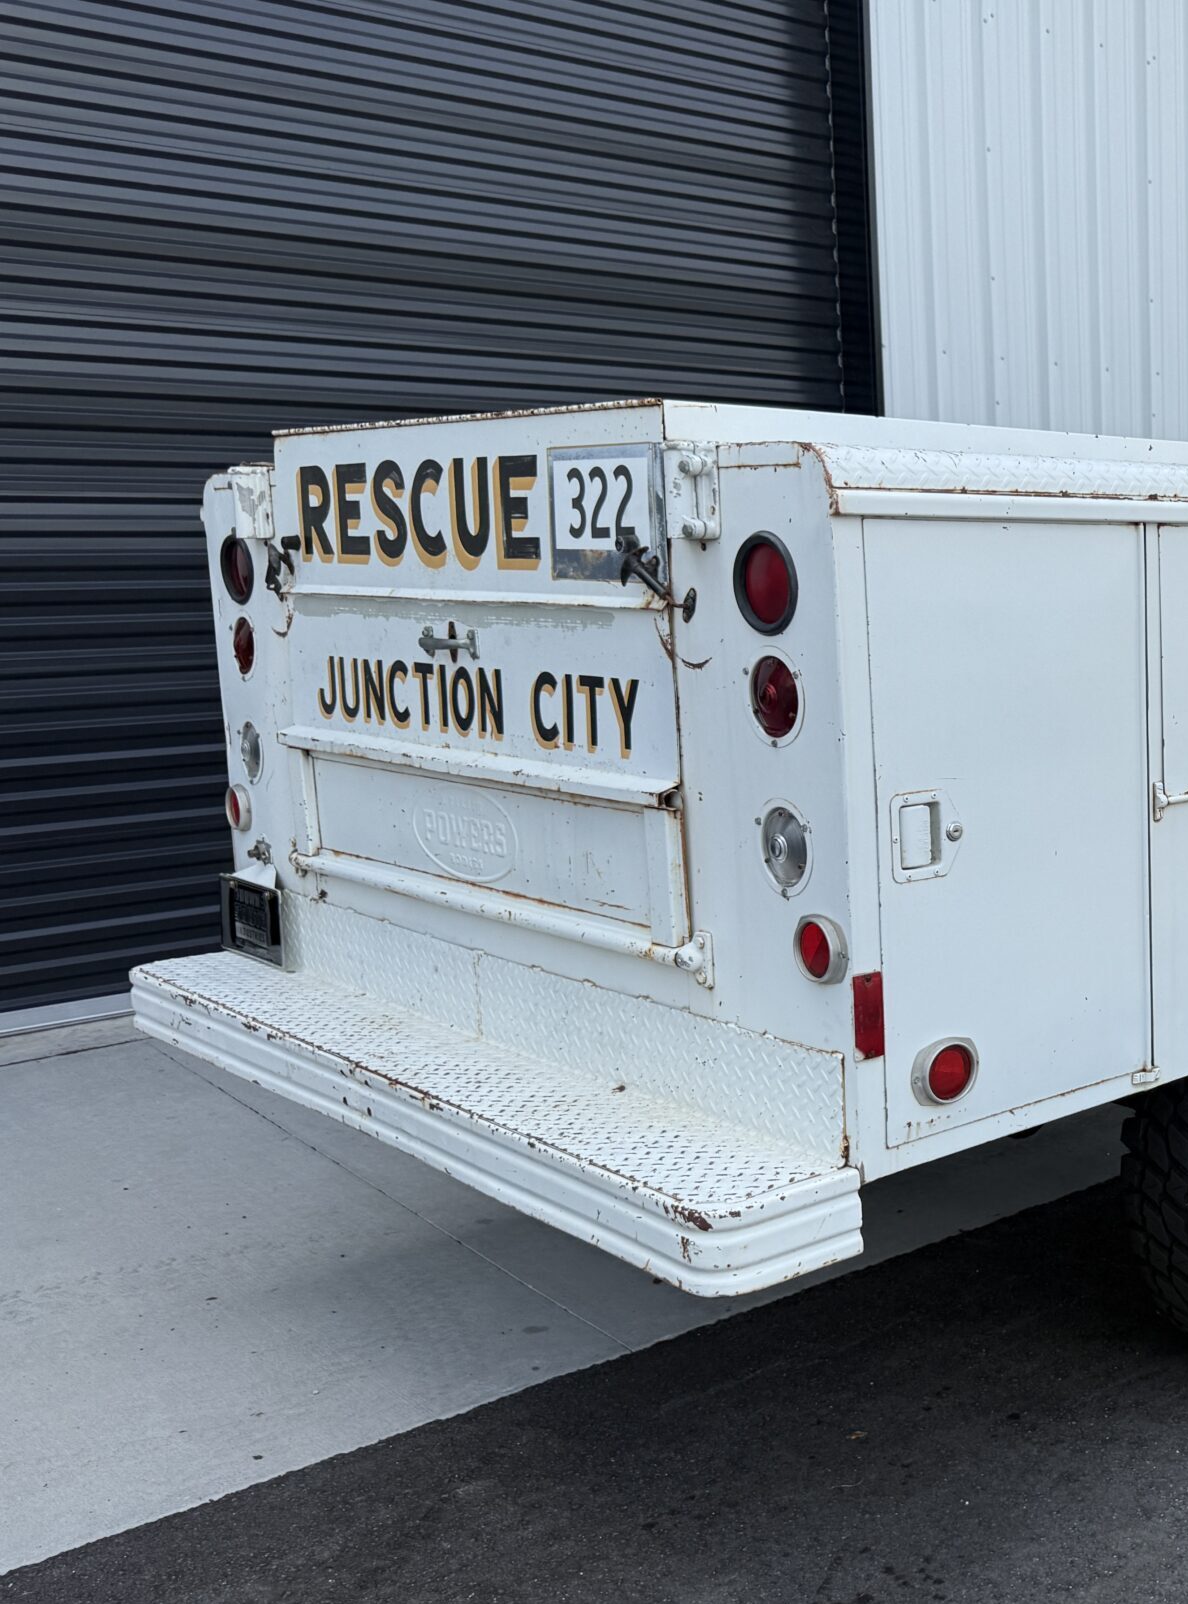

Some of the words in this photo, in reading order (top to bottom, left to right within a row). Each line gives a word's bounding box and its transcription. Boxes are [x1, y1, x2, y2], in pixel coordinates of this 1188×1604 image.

[296, 455, 542, 571] RESCUE
[566, 464, 635, 540] 322
[318, 655, 505, 742] JUNCTION
[531, 671, 640, 759] CITY
[423, 808, 508, 859] POWERS
